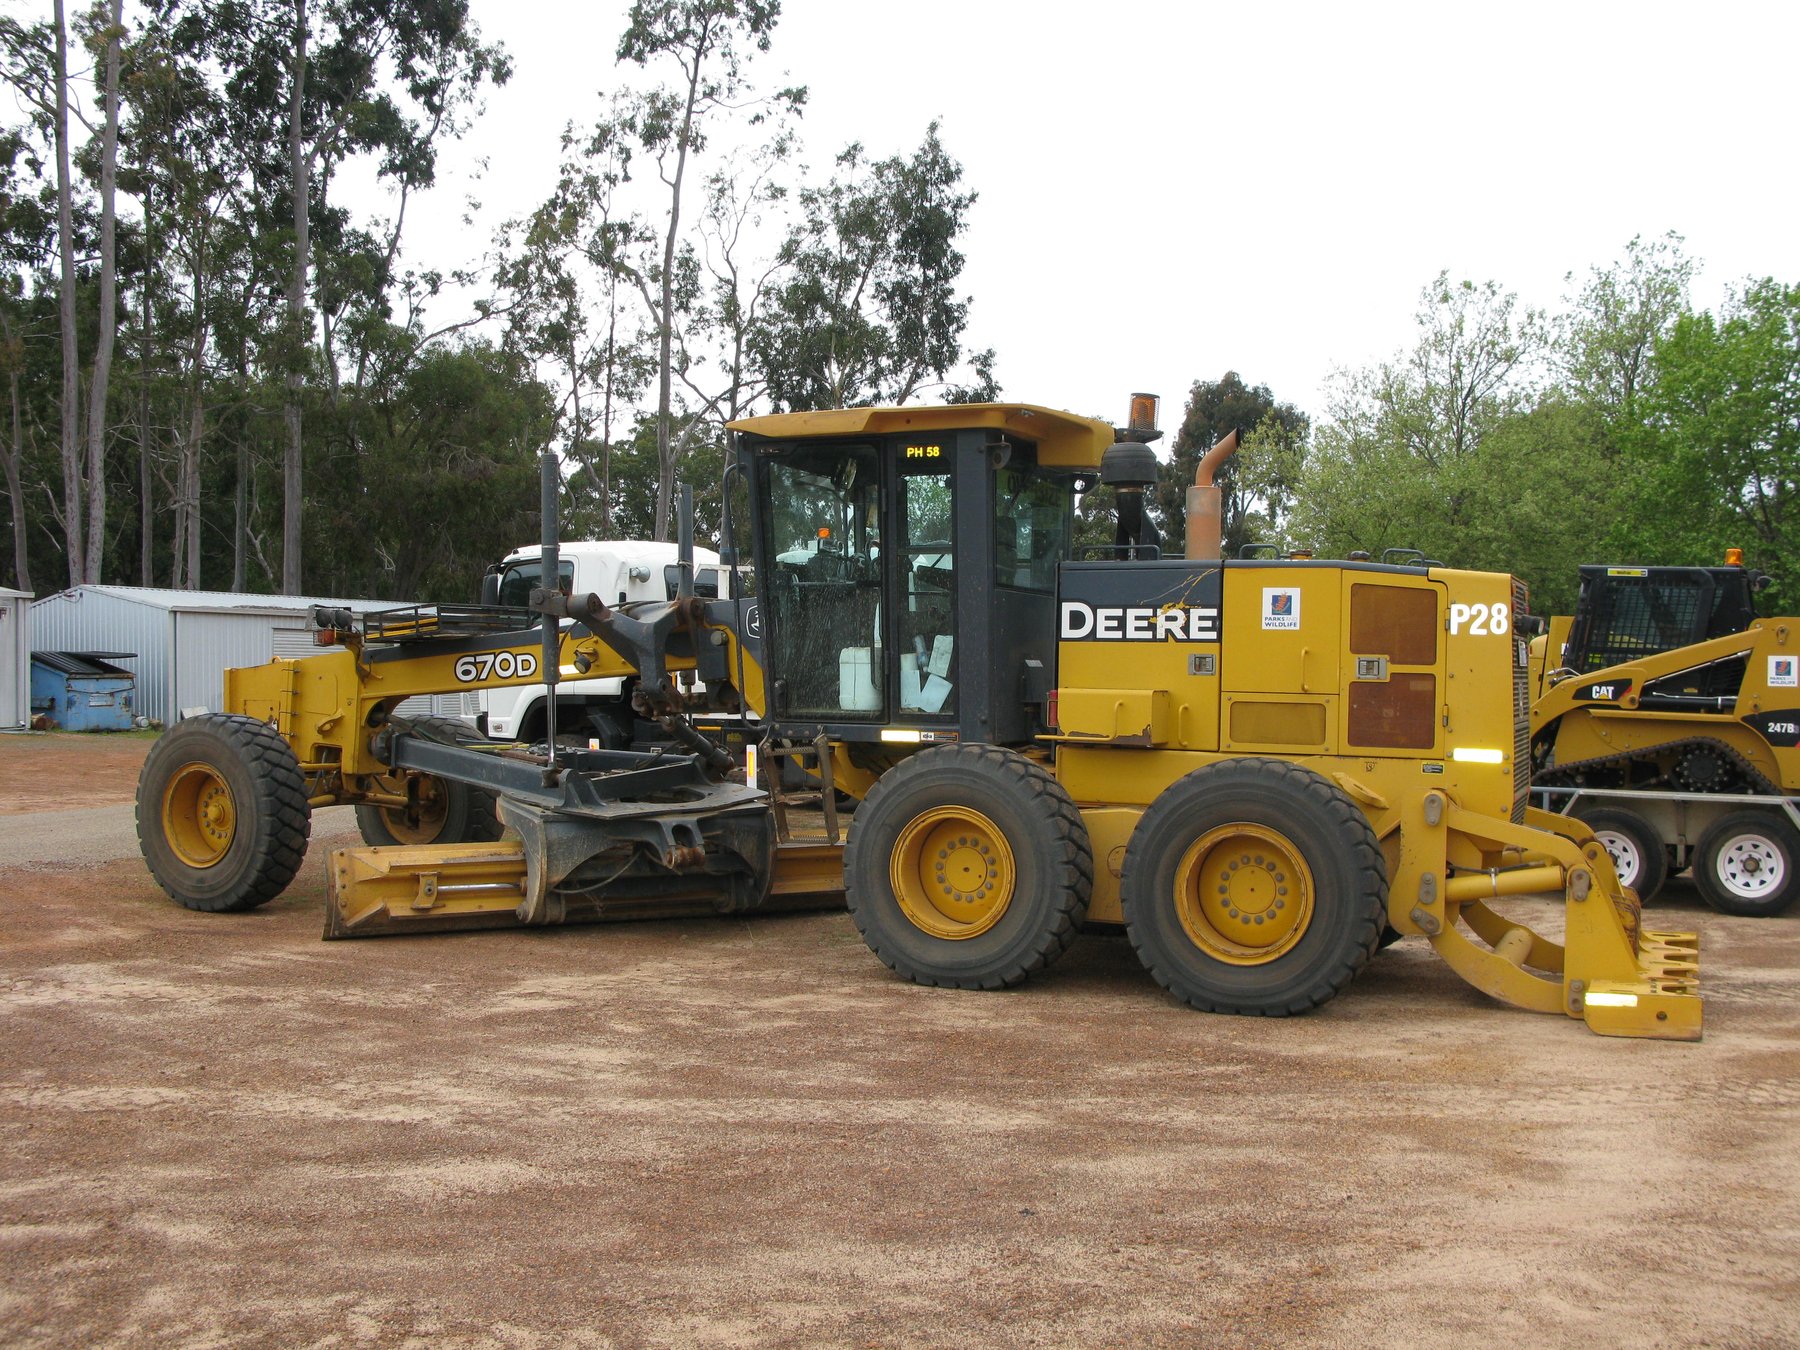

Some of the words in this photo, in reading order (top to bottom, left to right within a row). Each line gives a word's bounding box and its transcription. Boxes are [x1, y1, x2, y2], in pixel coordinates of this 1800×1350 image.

[906, 446, 924, 458] PH
[926, 445, 940, 457] 58
[1060, 601, 1218, 640] DEERE
[1450, 602, 1508, 635] P28
[455, 650, 538, 682] 670D
[1592, 685, 1615, 700] CAT
